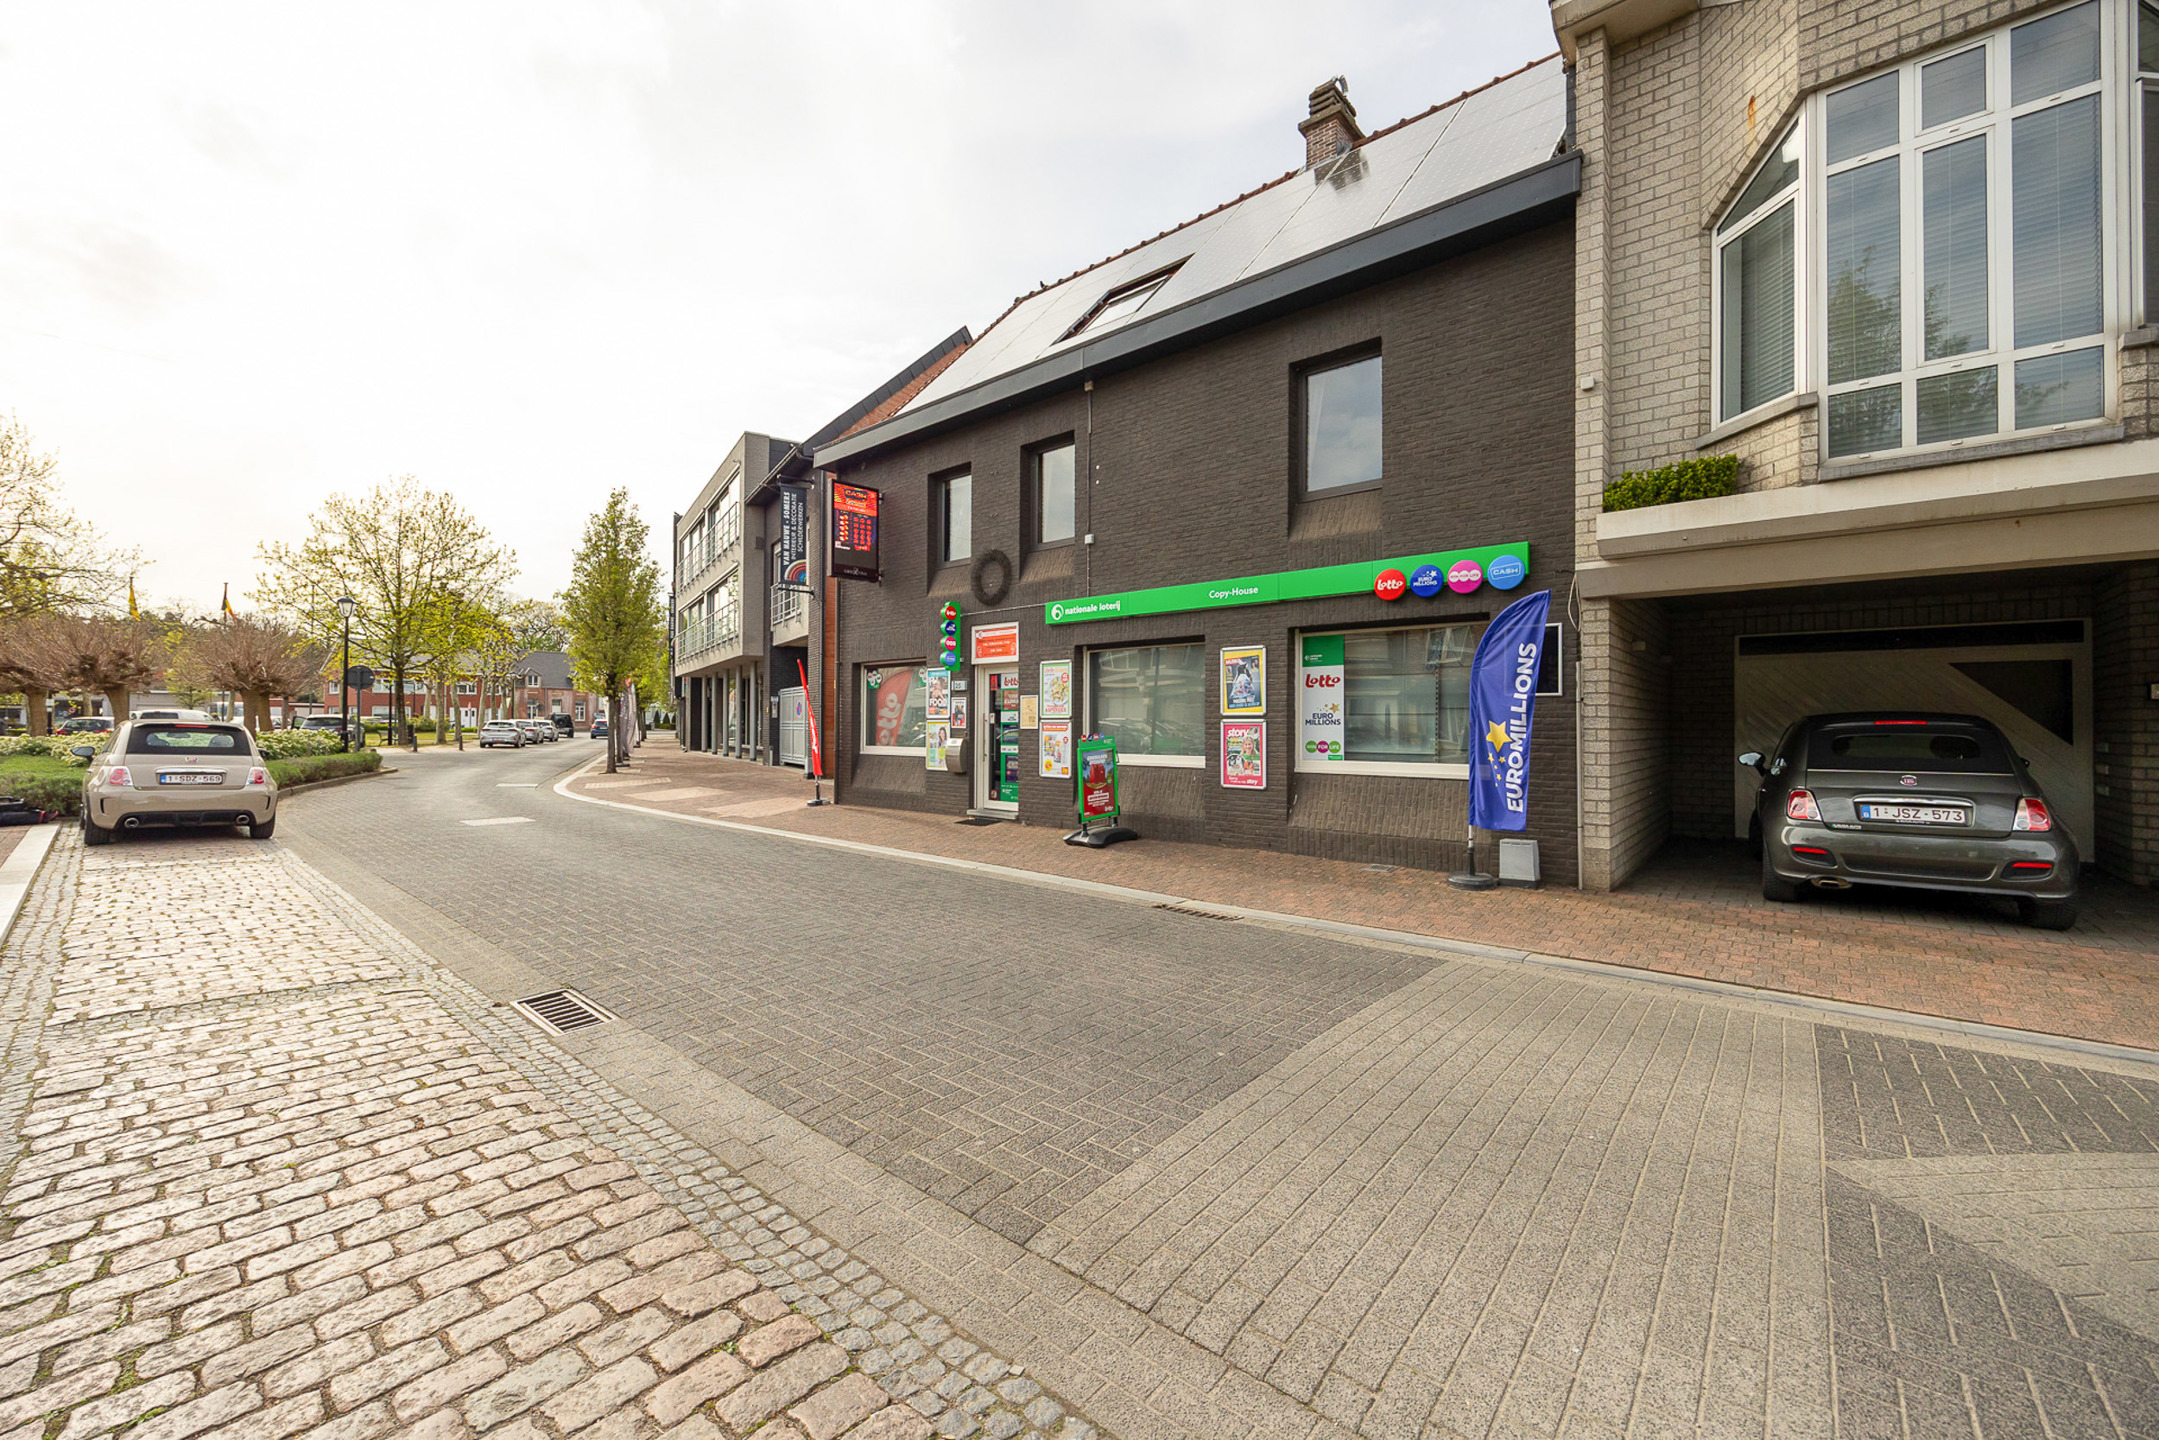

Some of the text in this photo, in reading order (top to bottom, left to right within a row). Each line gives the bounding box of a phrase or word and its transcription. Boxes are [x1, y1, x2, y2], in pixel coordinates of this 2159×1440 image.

[1493, 568, 1518, 576] CASH
[1208, 587, 1259, 599] Copy-House
[1064, 600, 1121, 615] nationale loterij
[1505, 643, 1537, 813] EUROMILLIONS
